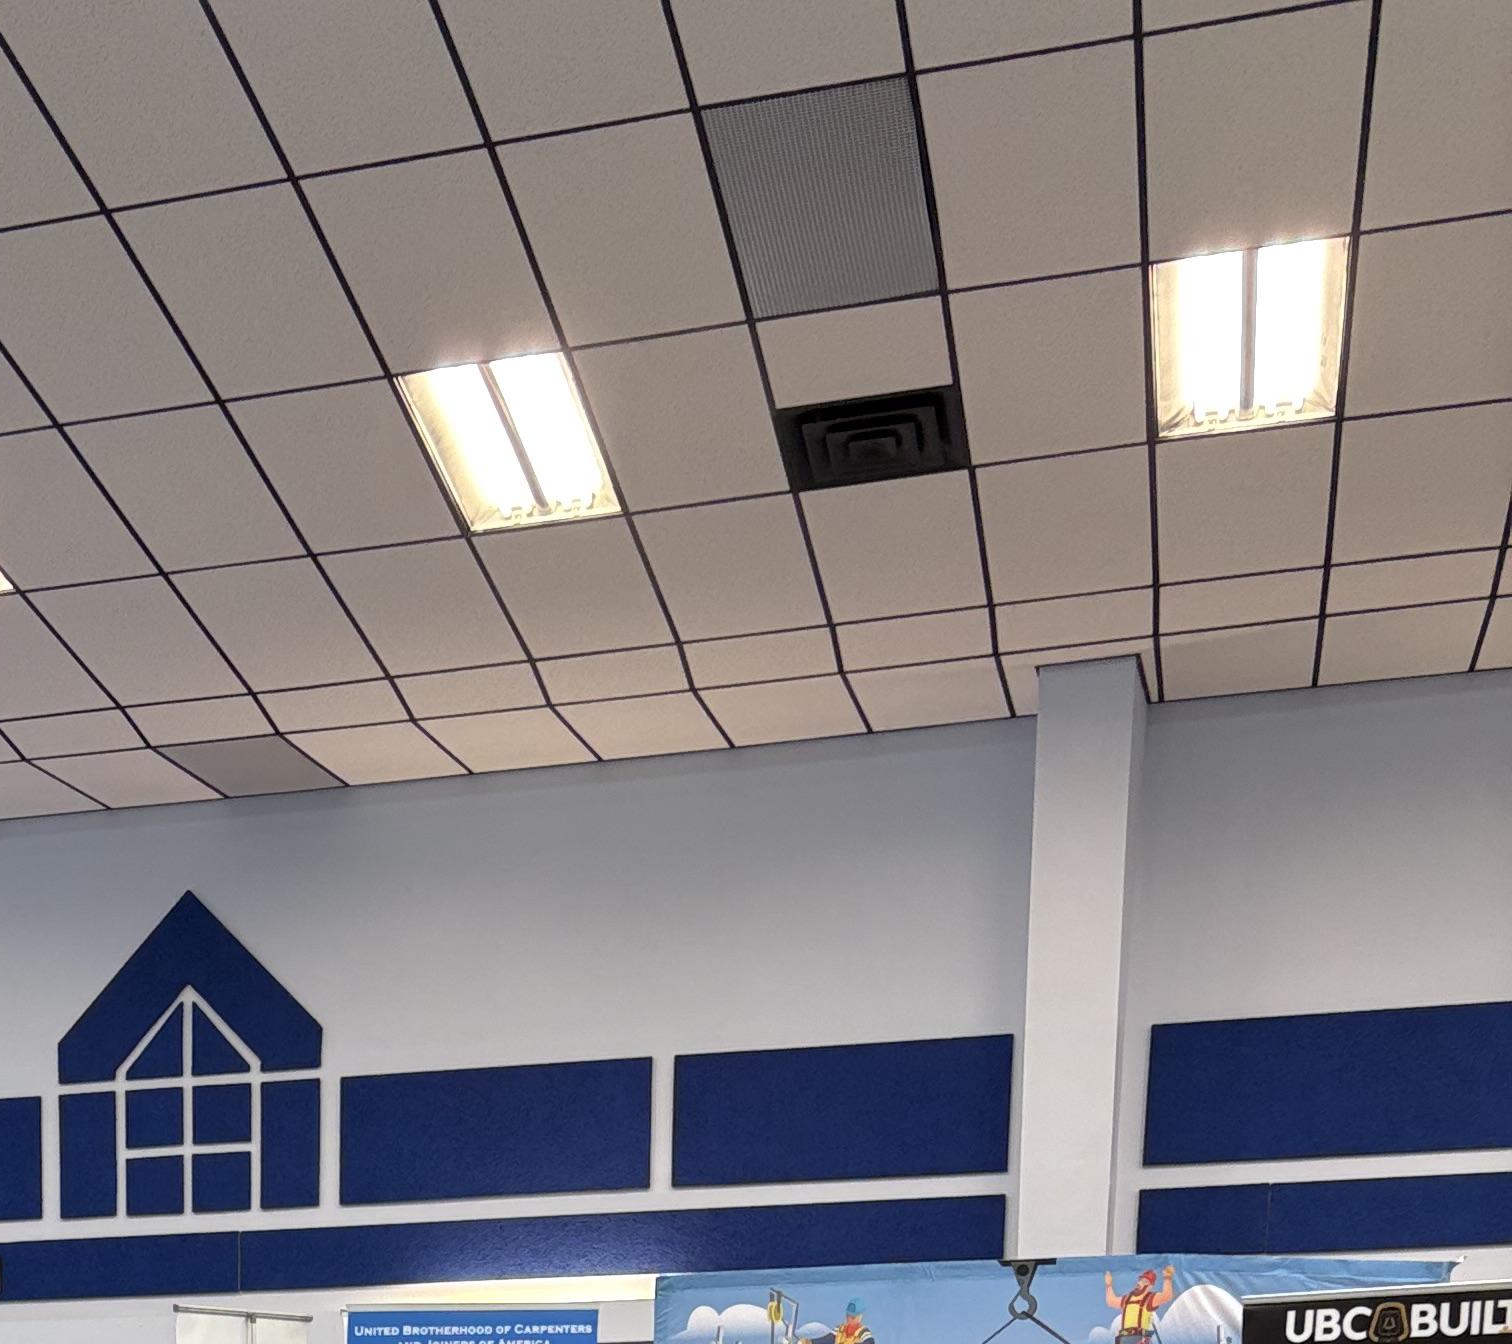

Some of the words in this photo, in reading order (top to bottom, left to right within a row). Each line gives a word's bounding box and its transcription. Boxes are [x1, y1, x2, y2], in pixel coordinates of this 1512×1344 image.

[354, 1325, 400, 1337] UNITED
[402, 1324, 493, 1336] BROTHERHOOD
[496, 1324, 511, 1335] OF
[514, 1323, 592, 1335] CARPENTERS
[1286, 1306, 1371, 1343] UBC
